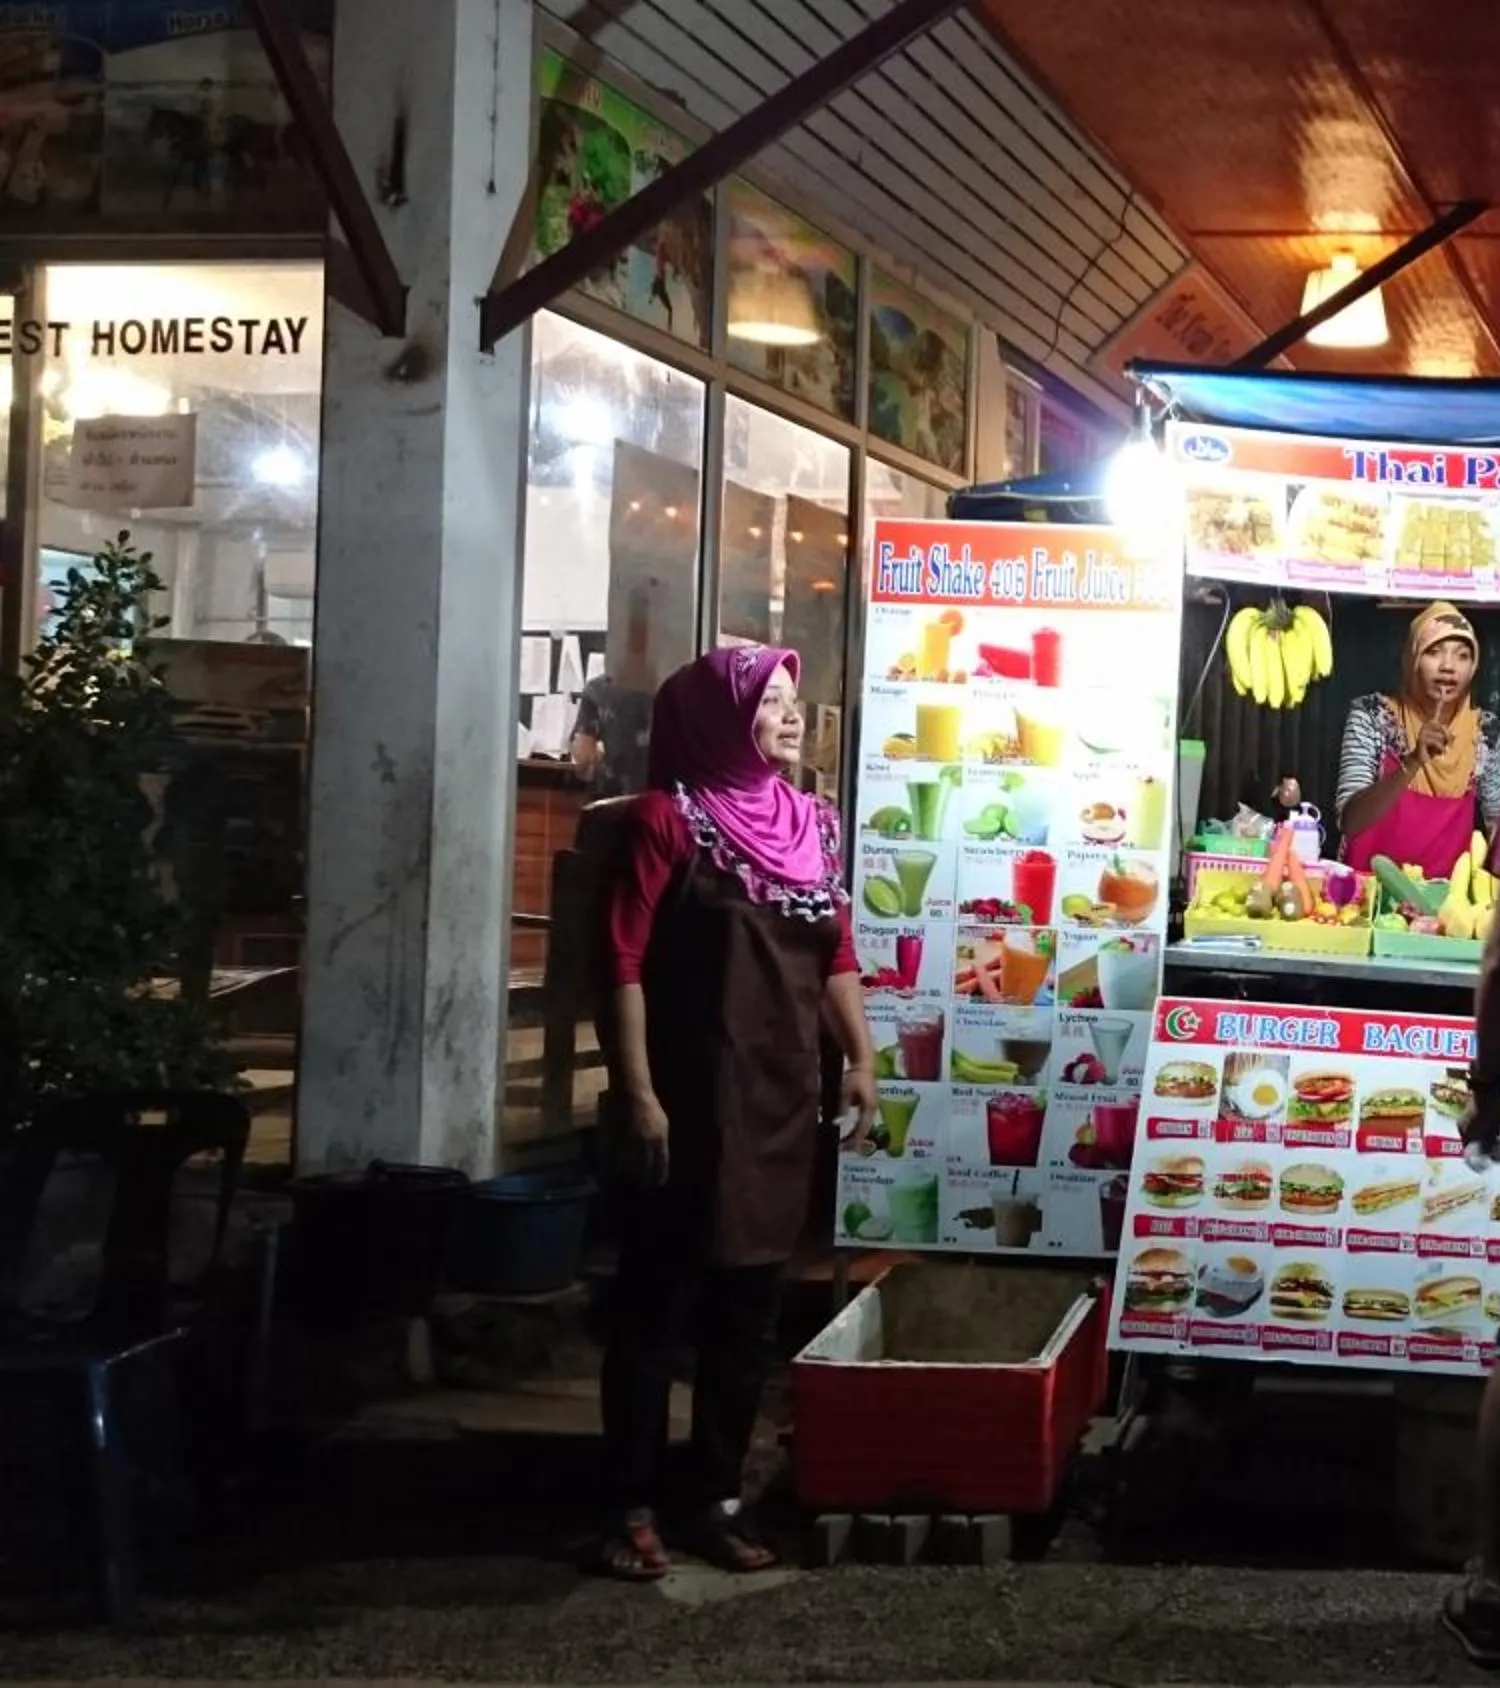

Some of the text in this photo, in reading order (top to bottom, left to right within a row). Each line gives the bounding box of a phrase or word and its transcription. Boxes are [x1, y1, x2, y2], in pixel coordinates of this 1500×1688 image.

[91, 316, 308, 356] HOMESTAY
[1344, 446, 1446, 487] Thai
[879, 544, 923, 594] Fruit
[928, 546, 984, 596] Shake
[1032, 548, 1076, 599] Fruit
[1081, 553, 1129, 601] Juice
[1060, 1012, 1098, 1025] Lychee
[1216, 1012, 1340, 1047] BURGER
